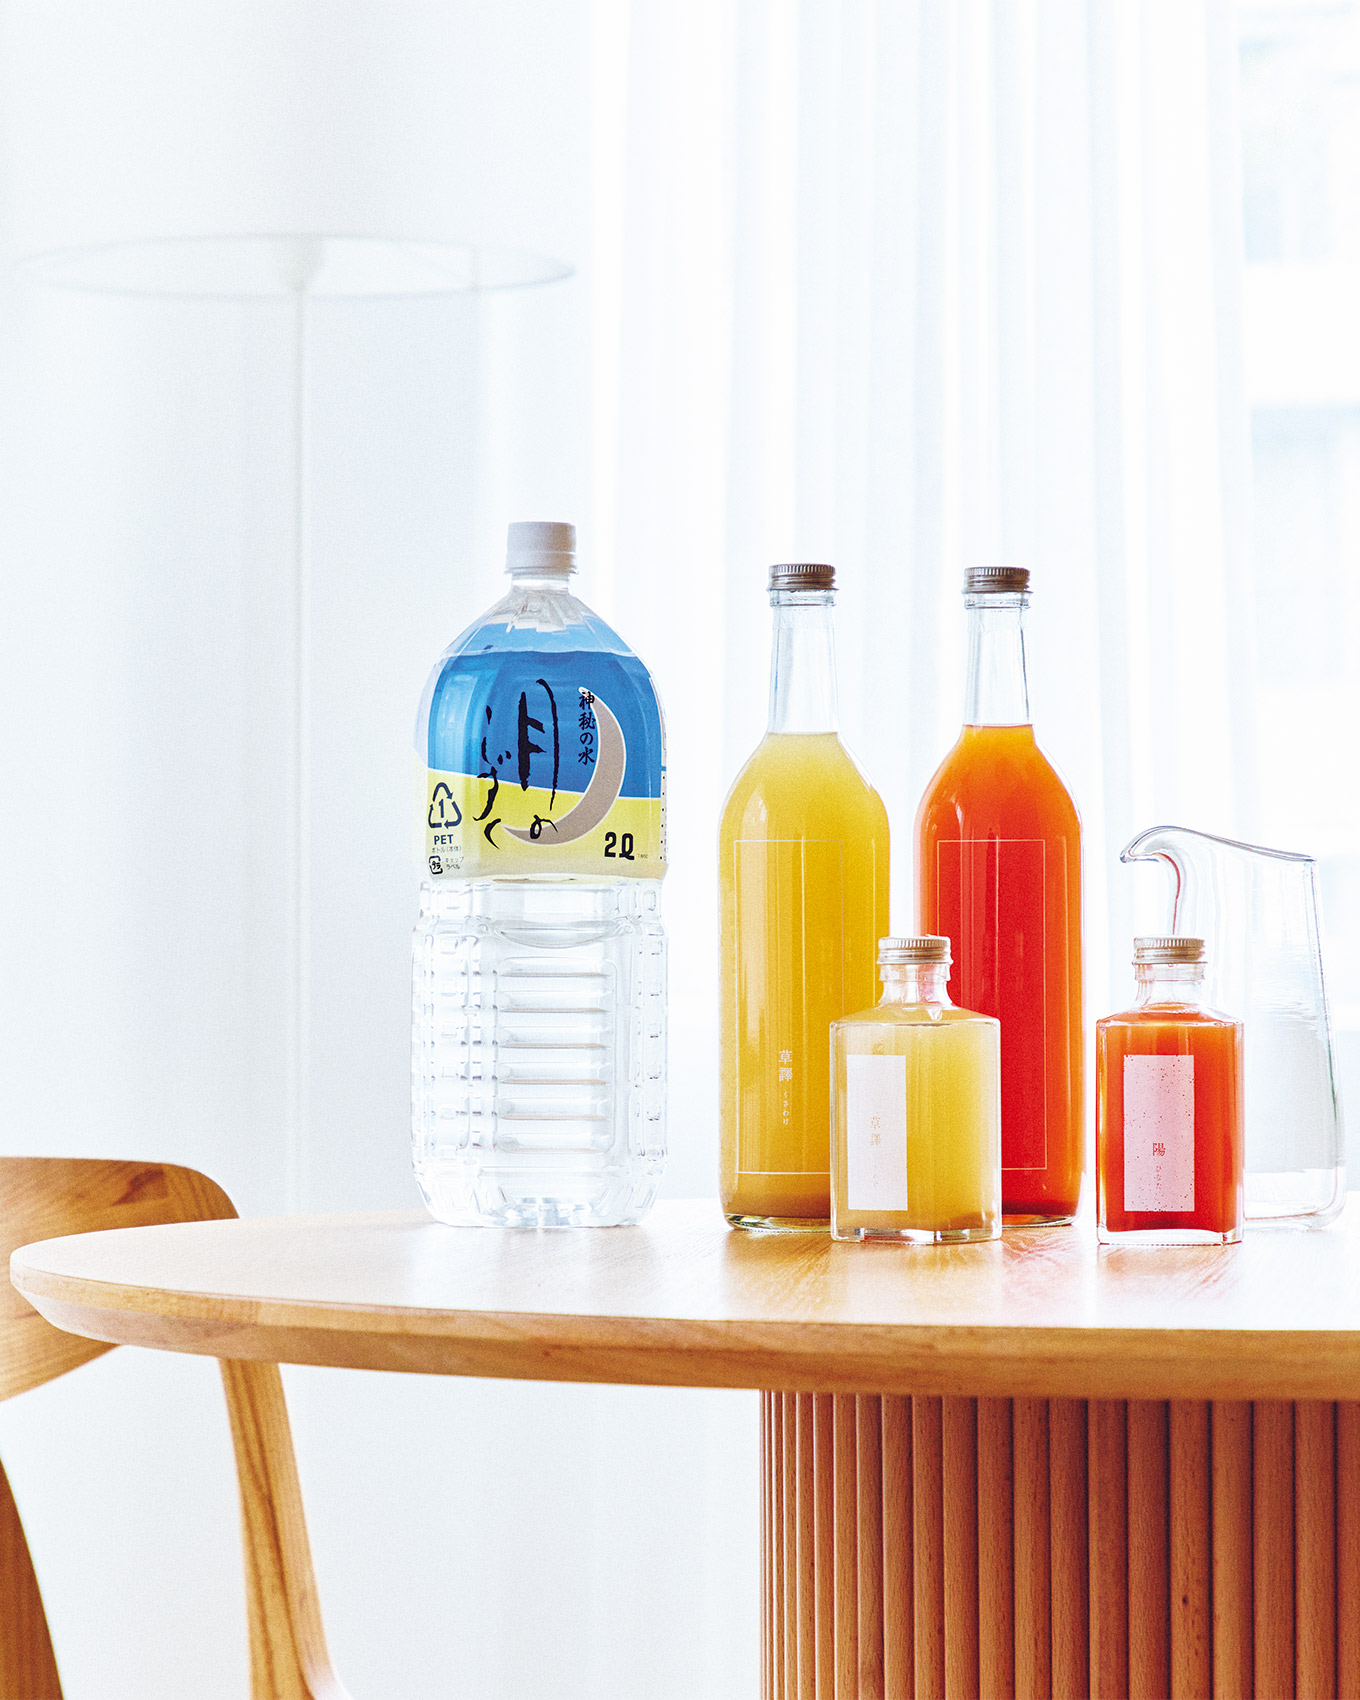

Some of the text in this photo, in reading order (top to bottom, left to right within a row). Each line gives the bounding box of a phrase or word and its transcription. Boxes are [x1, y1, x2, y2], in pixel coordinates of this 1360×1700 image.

[578, 691, 597, 766] 神秘の水
[433, 834, 454, 845] PET
[1152, 1142, 1166, 1157] 陽
